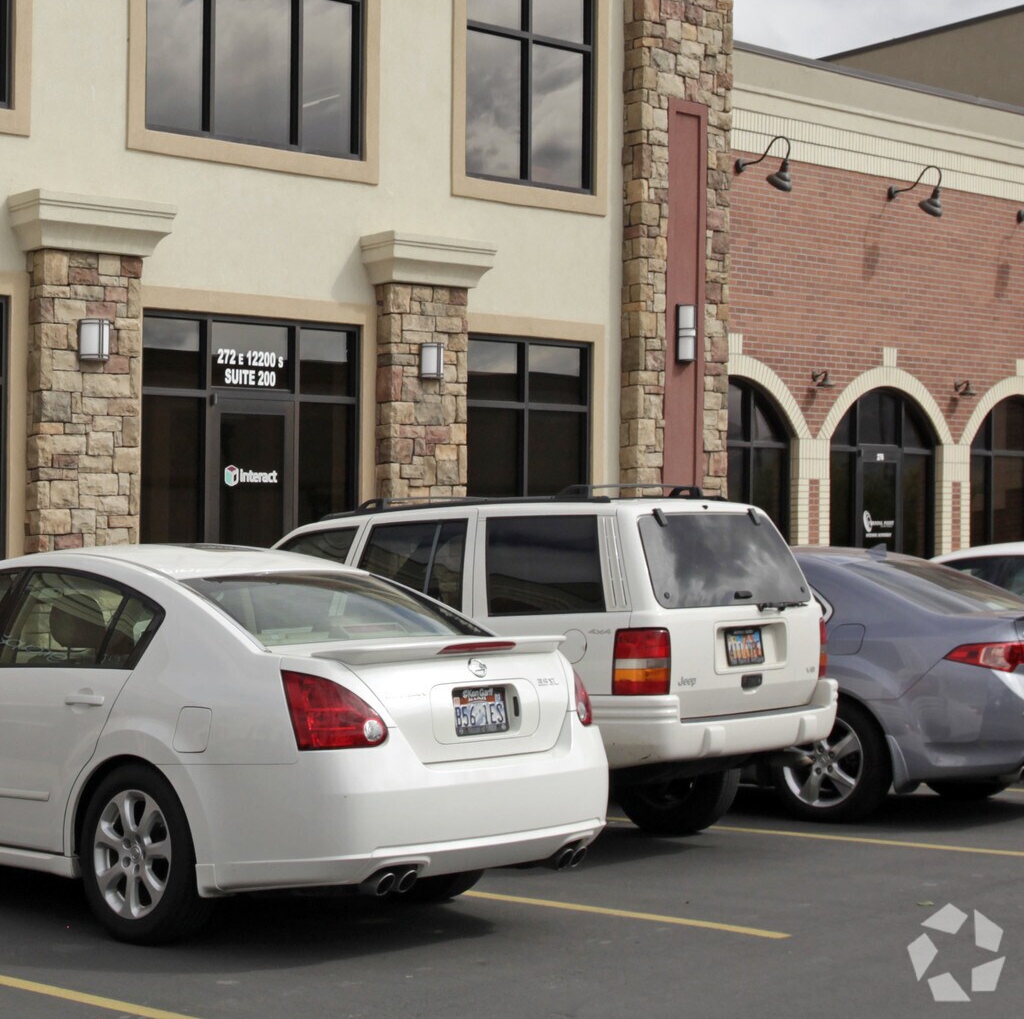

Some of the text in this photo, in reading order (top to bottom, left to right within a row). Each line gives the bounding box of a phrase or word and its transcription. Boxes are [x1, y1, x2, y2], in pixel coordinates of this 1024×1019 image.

[217, 348, 284, 368] 272 E 12200 S
[224, 368, 276, 387] SUITE 200
[239, 468, 278, 483] interact
[677, 676, 697, 688] Jeep
